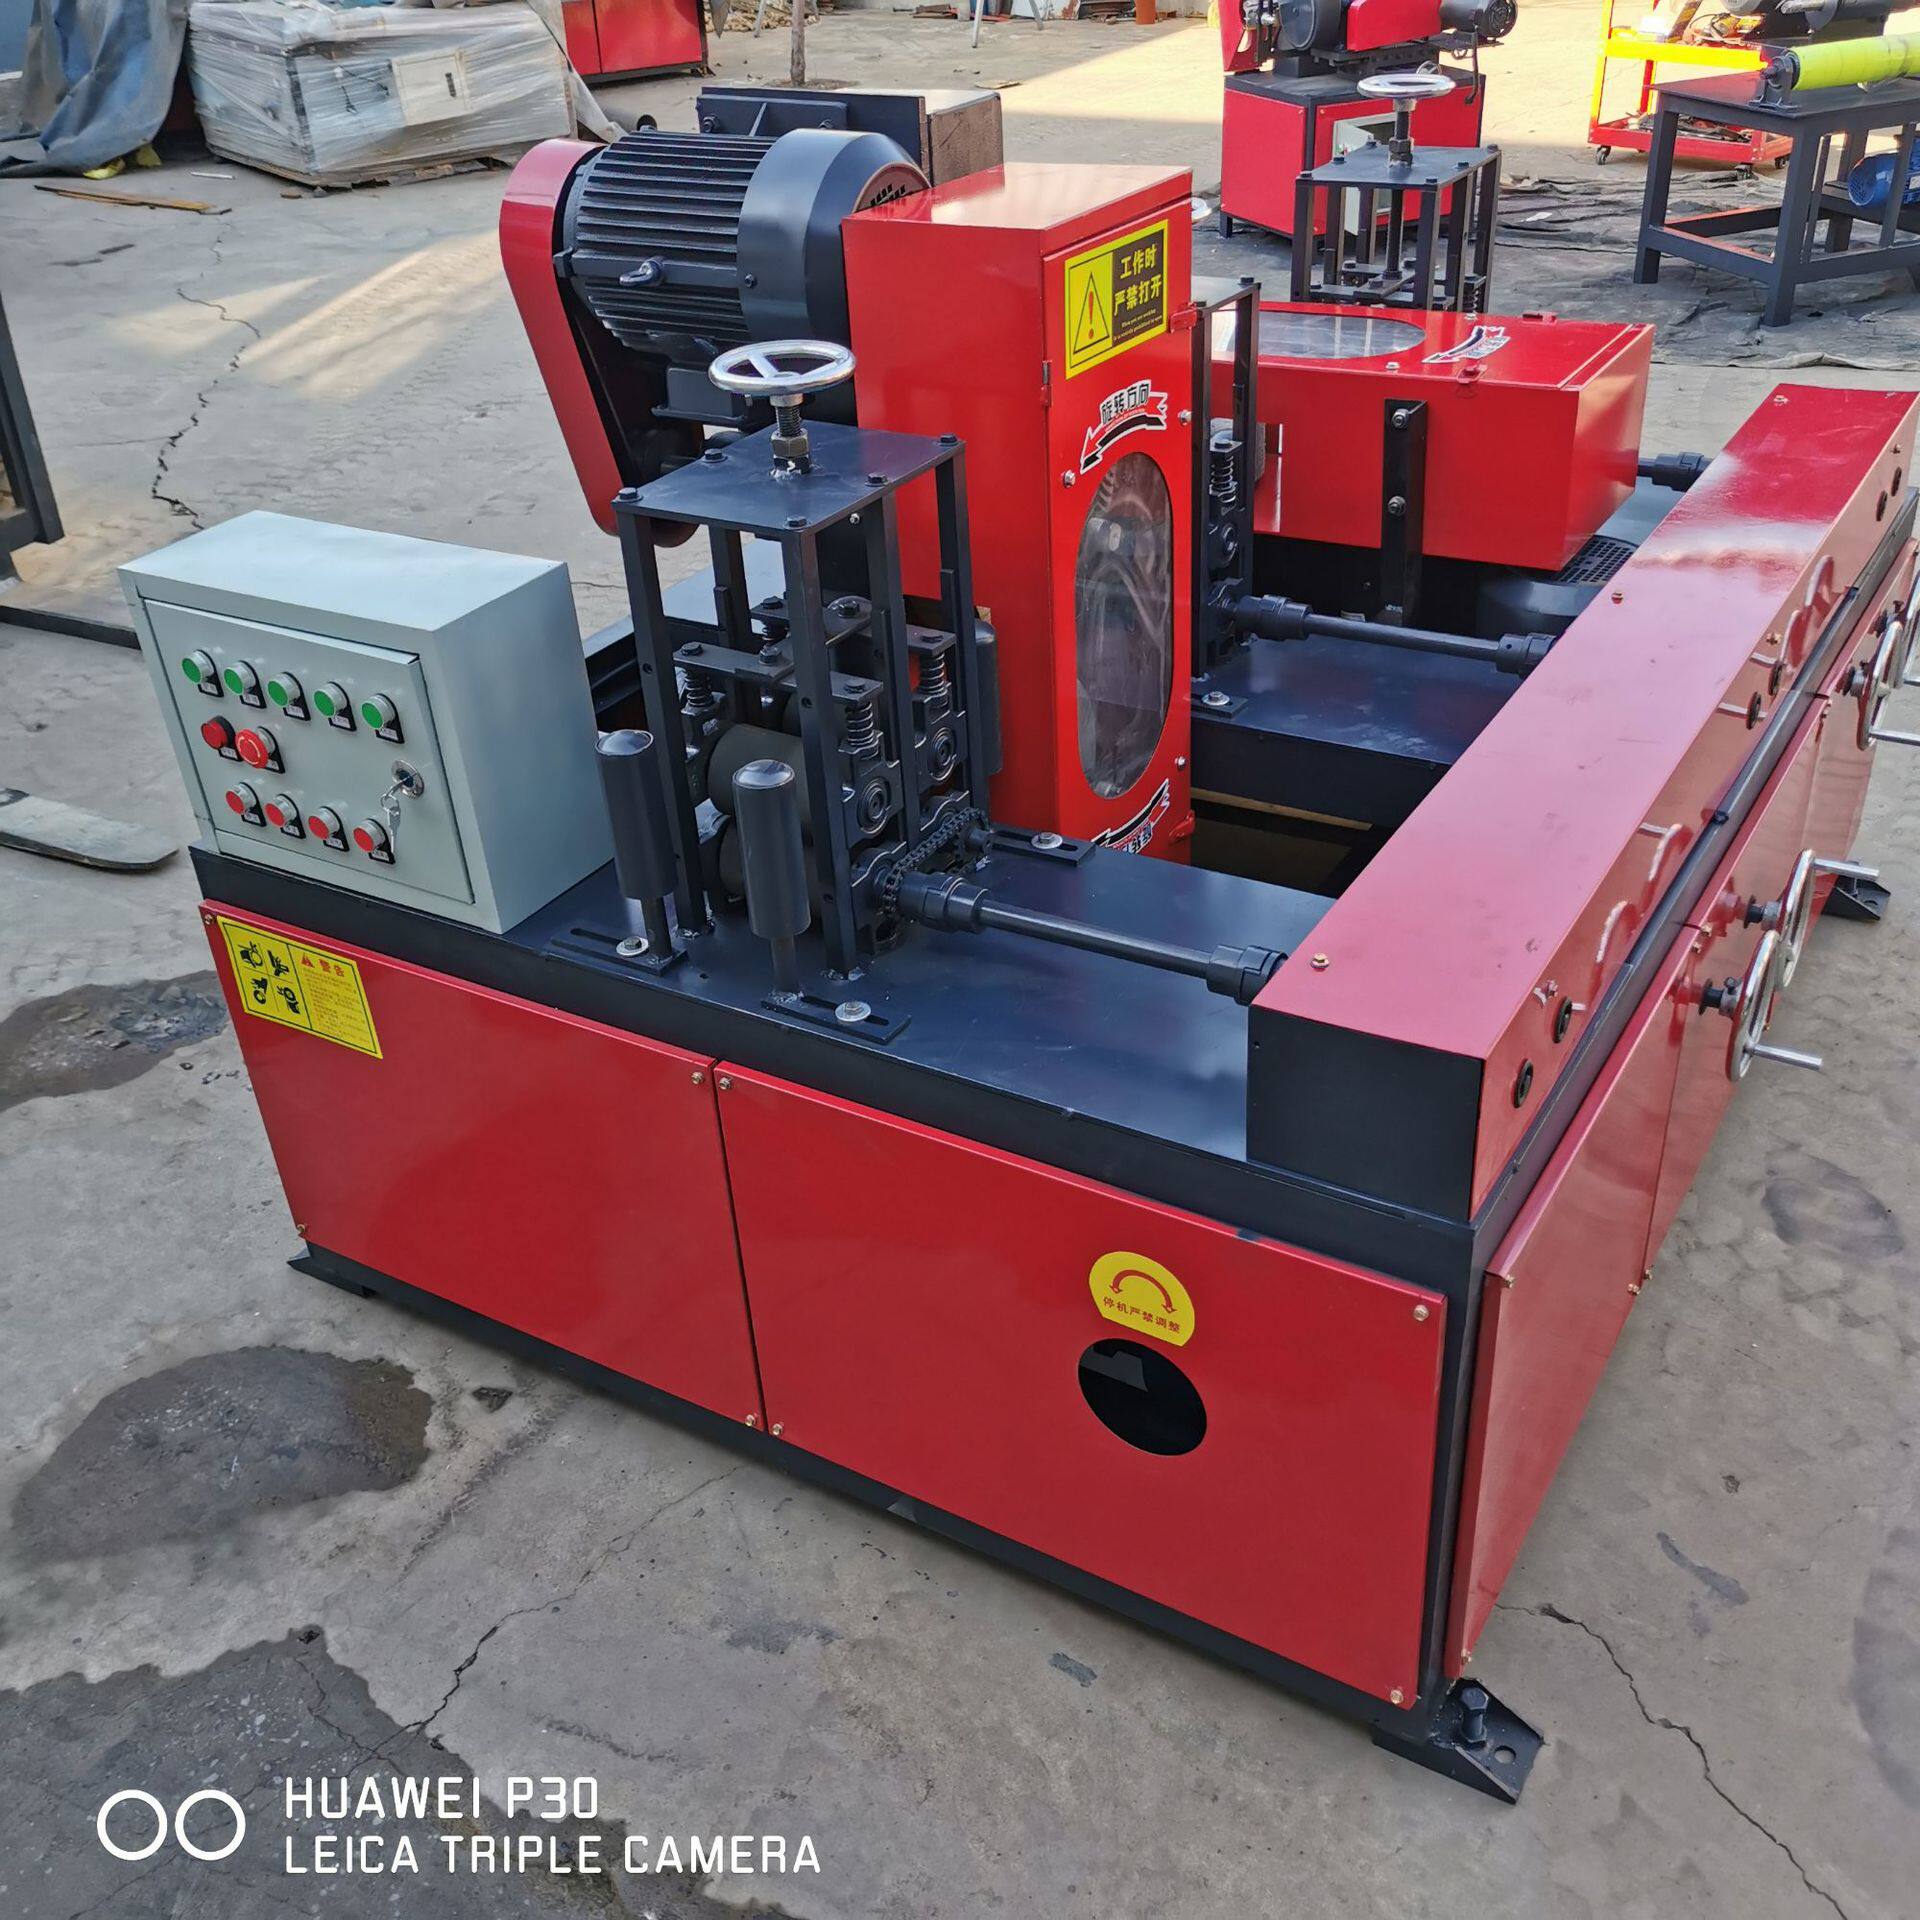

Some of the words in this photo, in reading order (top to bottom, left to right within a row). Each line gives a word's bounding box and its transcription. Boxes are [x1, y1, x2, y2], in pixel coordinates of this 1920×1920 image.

[1119, 243, 1157, 279] 工作时
[1113, 273, 1162, 316] 严禁打开
[1101, 383, 1149, 424] 旋转方向
[1103, 1296, 1181, 1333] 停机严禁调整
